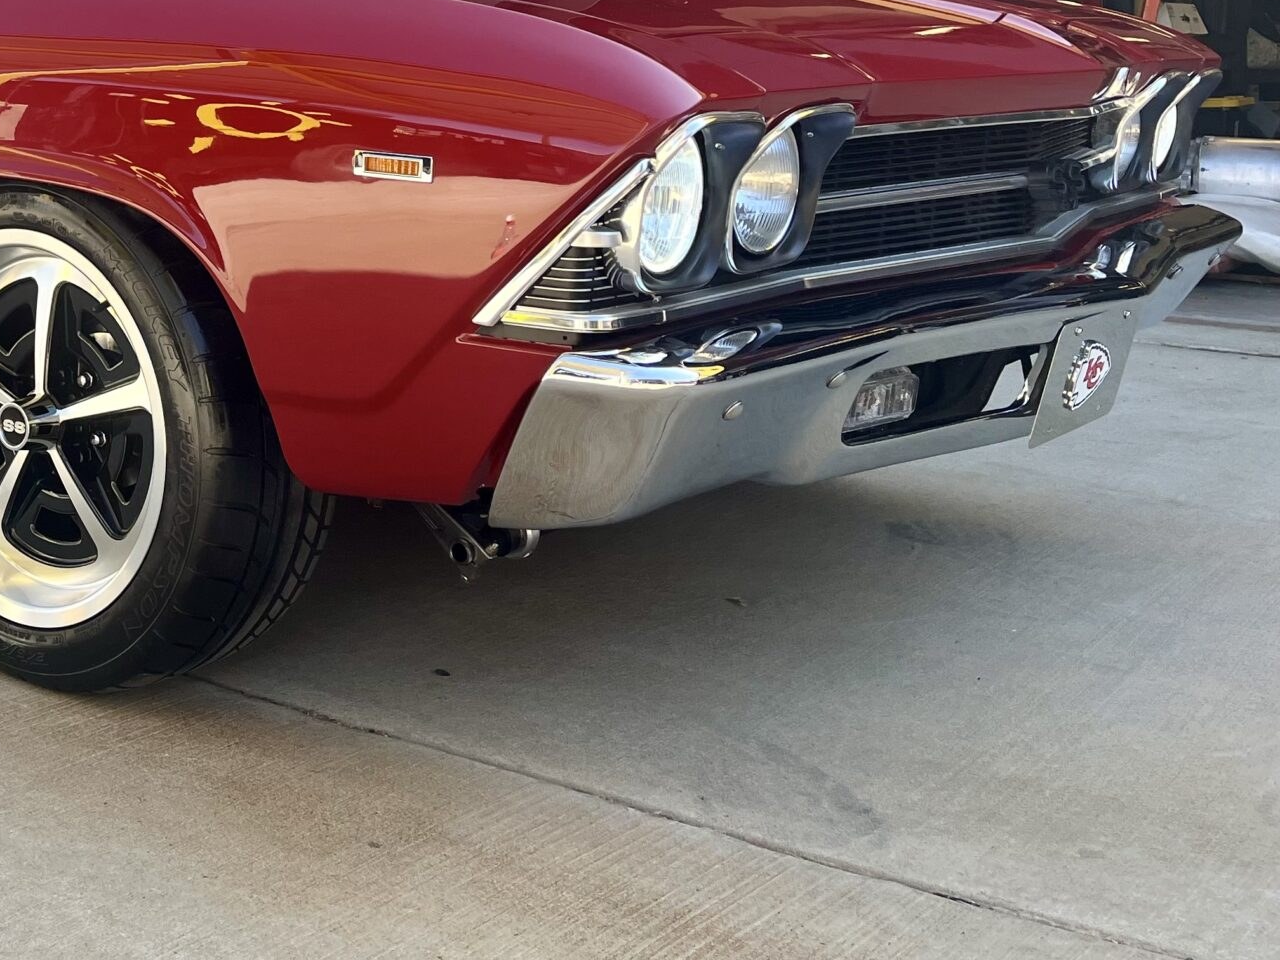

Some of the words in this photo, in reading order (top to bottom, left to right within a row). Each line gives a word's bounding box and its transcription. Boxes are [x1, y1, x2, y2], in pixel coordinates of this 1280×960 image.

[103, 243, 189, 393] MICKEY
[1083, 355, 1105, 390] KC
[2, 418, 26, 435] SS
[122, 414, 196, 637] THOMPSON
